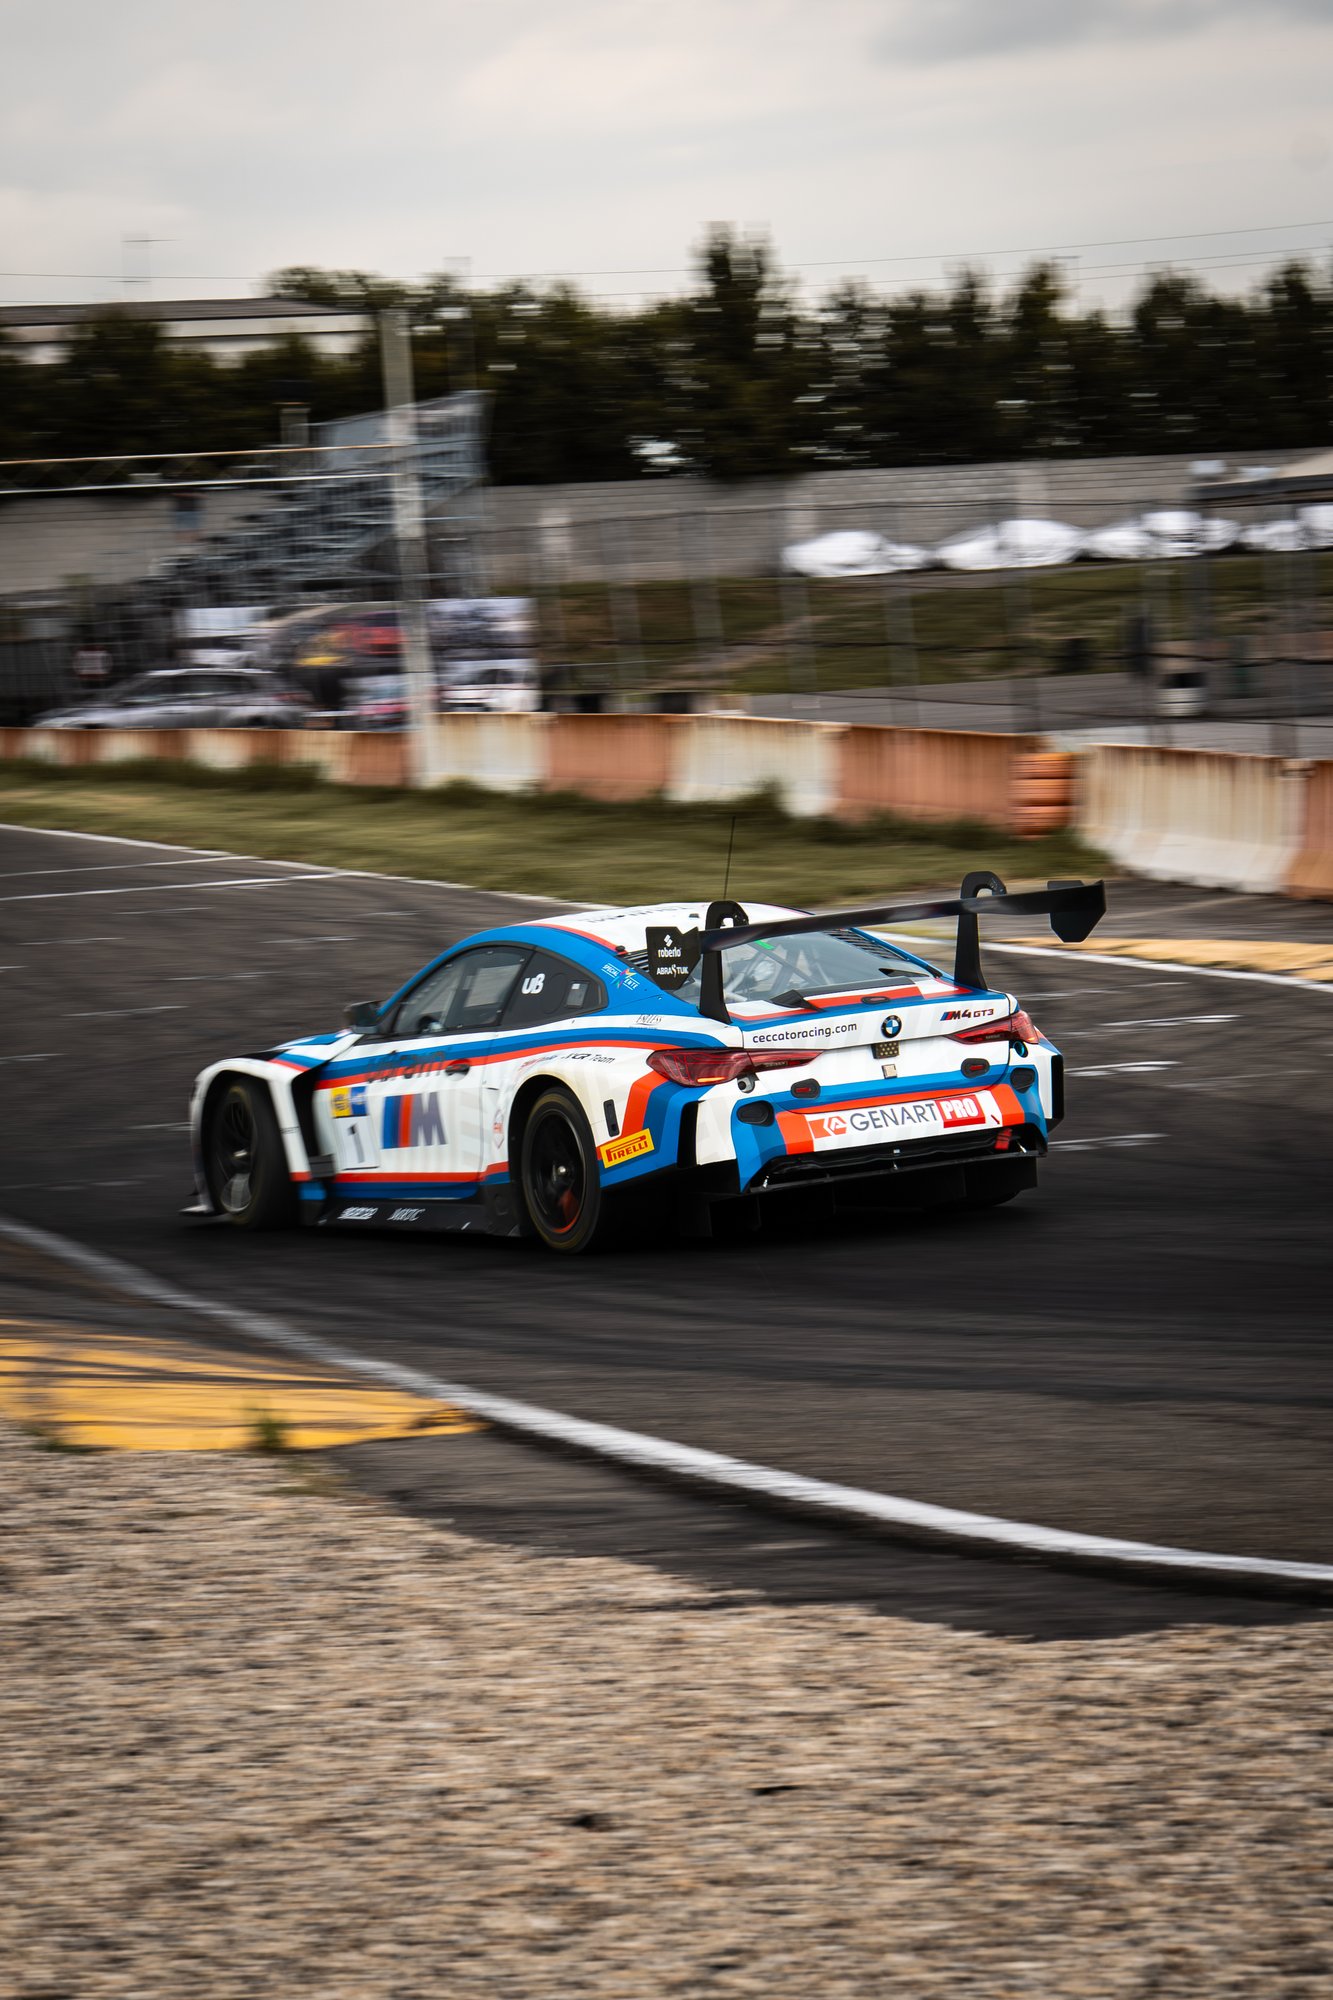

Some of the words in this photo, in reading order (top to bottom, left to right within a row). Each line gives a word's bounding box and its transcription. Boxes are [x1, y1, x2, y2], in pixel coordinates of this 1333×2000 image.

[657, 947, 682, 958] roberlo
[948, 1010, 972, 1022] M4
[973, 1008, 994, 1018] GT3
[752, 1023, 857, 1044] ceccatoracing.com
[849, 1102, 938, 1132] GENART
[939, 1097, 979, 1120] PRO
[347, 1122, 366, 1164] 1
[605, 1135, 649, 1163] PIRELLI
